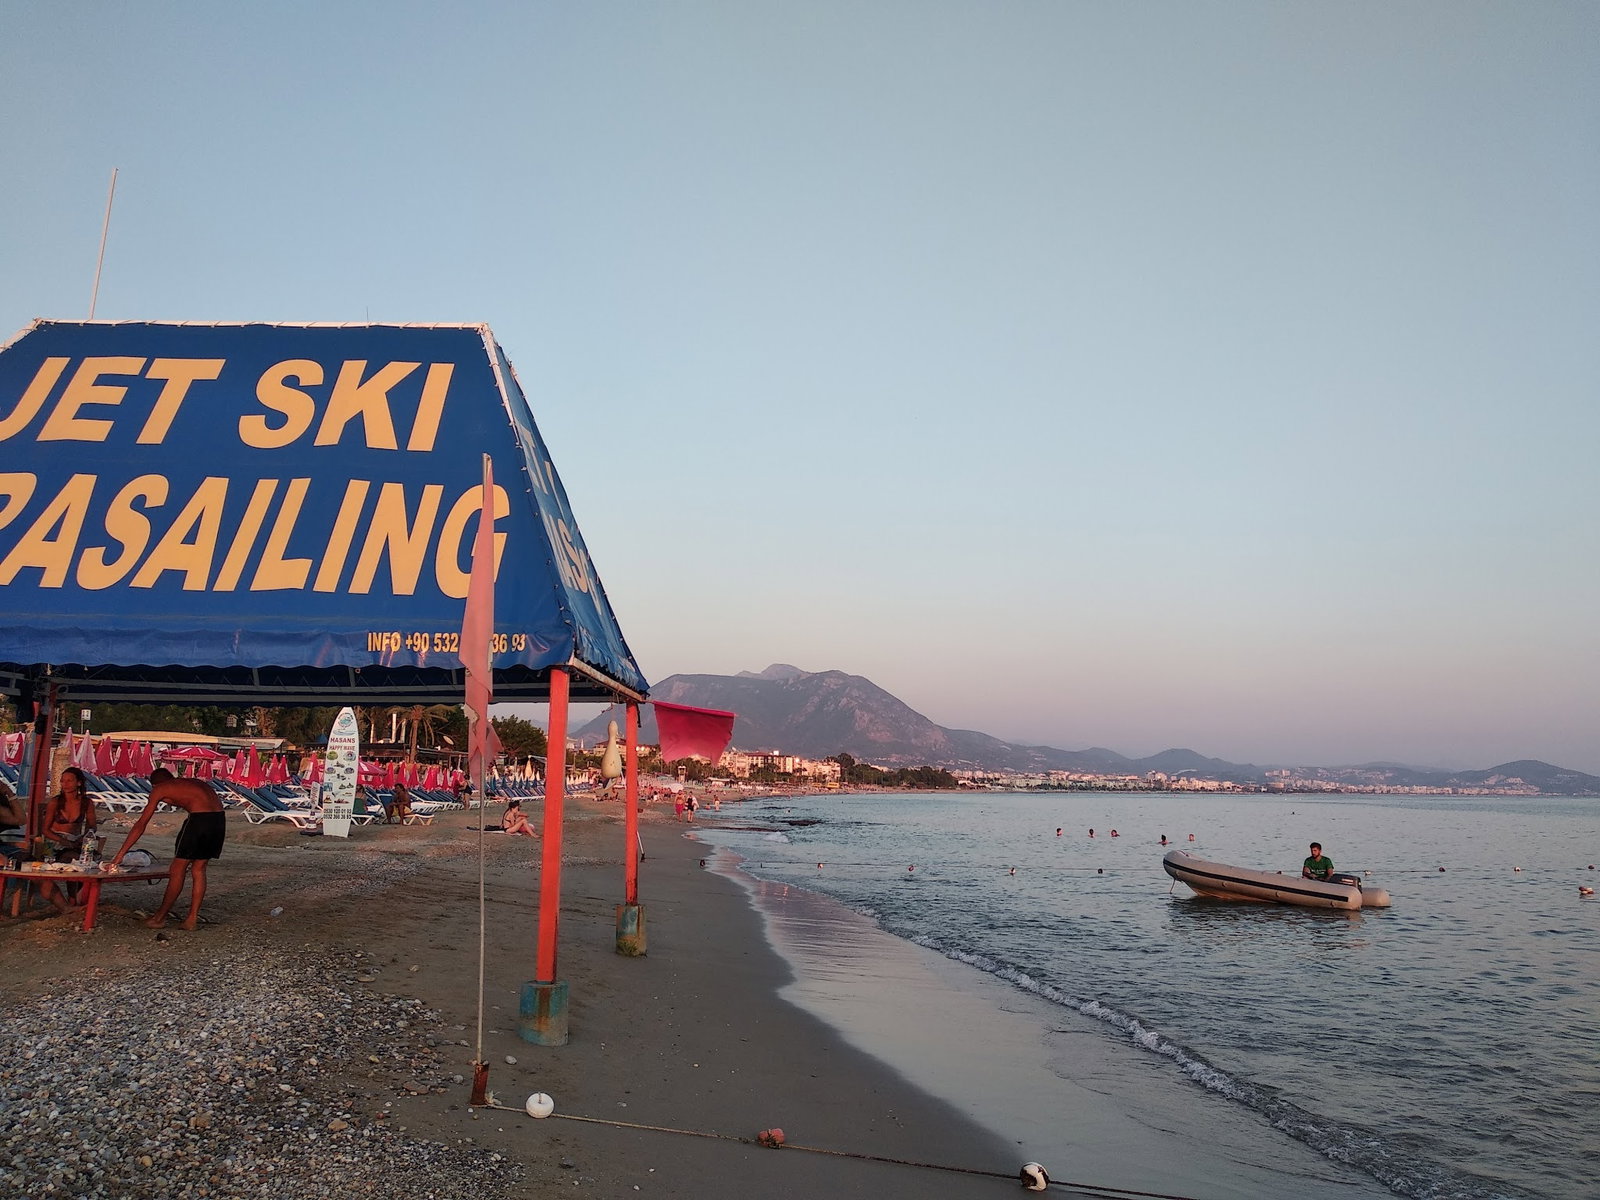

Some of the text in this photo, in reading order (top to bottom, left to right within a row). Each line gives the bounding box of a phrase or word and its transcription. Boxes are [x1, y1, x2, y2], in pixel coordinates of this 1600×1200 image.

[0, 357, 455, 452] JET SKI
[367, 632, 402, 653] INFO
[405, 632, 430, 653] +90
[433, 632, 459, 653] 532
[511, 633, 527, 653] 93
